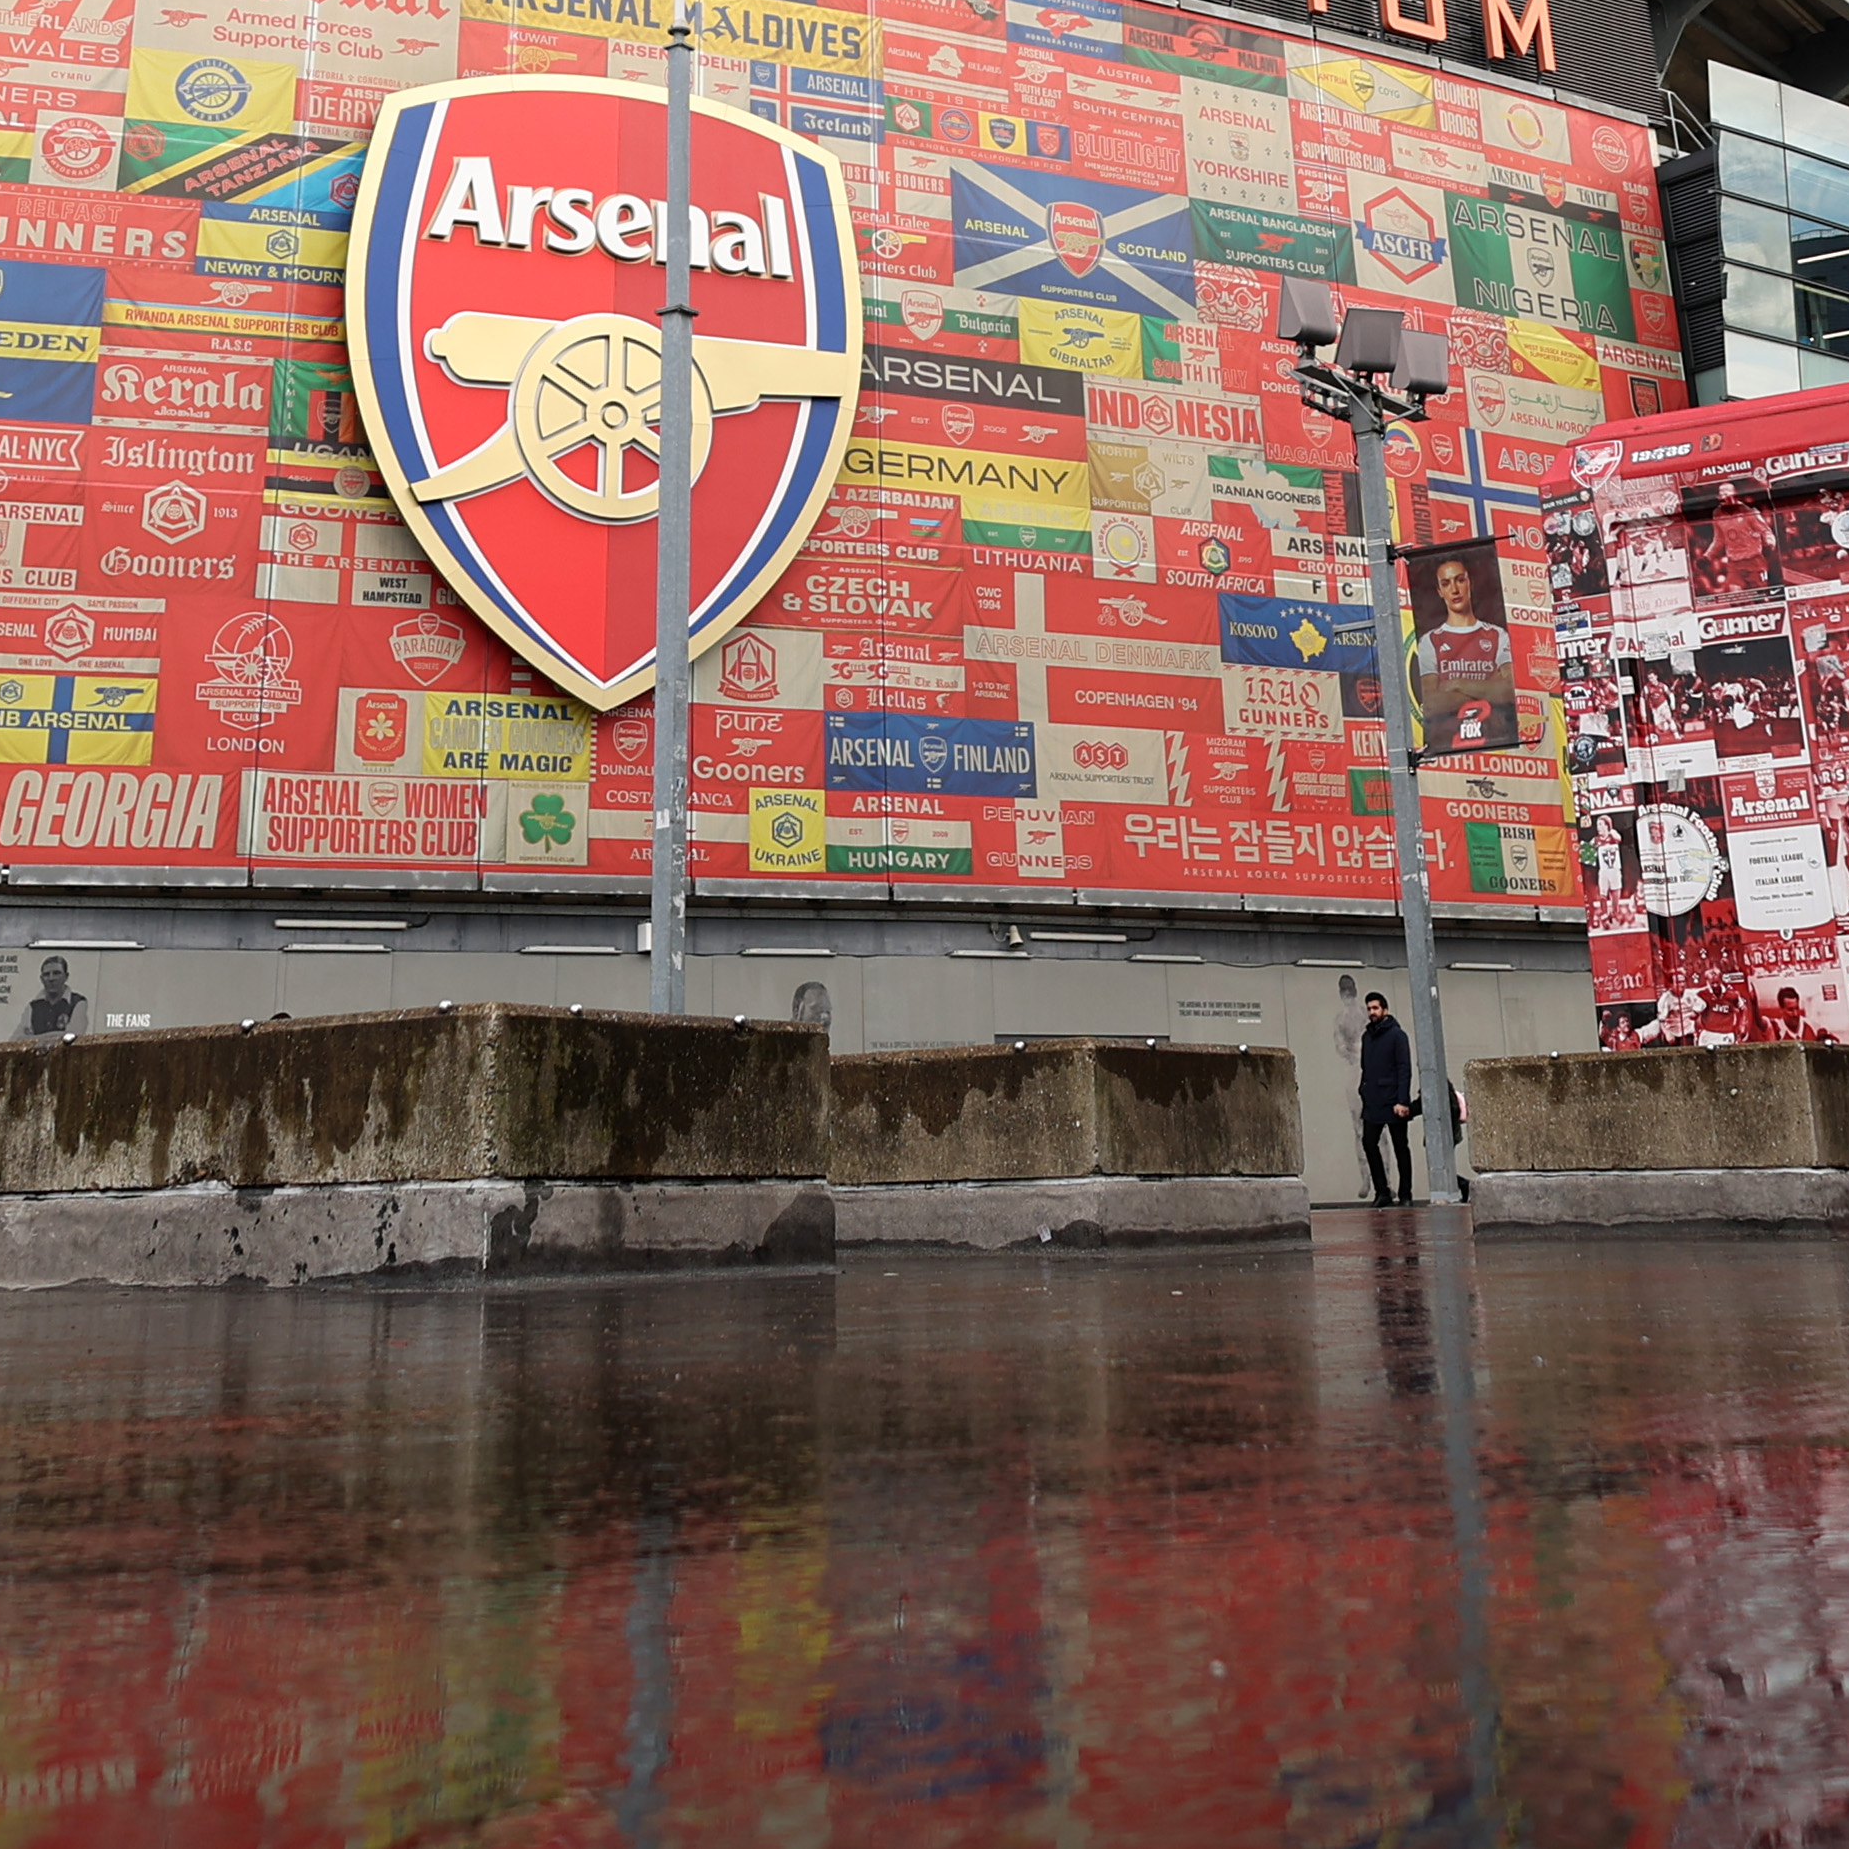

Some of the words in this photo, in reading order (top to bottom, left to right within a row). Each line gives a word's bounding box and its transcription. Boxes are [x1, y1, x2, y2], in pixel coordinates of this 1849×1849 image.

[213, 26, 332, 52] Supporters
[337, 41, 384, 60] Club
[807, 74, 867, 98] ARSENAL
[1096, 66, 1153, 84] AUSTRIA
[1072, 100, 1118, 117] SOUTH
[1122, 109, 1179, 128] CENTRAL
[1199, 106, 1276, 133] ARSENAL
[1073, 131, 1180, 172] BLUELIGHT
[1193, 159, 1289, 188] YORKSHIRE
[424, 157, 794, 282] Arsenal
[1452, 198, 1620, 261] ARSENAL
[1372, 231, 1433, 261] ASCFR
[1225, 249, 1293, 270] SUPPORTERS
[1297, 258, 1326, 275] CLUB
[1474, 278, 1618, 333] NIGERIA
[1602, 345, 1678, 374] ARSENAL
[101, 363, 265, 411] Kerala
[859, 355, 1061, 404] ARSENAL
[101, 437, 255, 477] Islington
[844, 448, 1070, 495] GERMANY
[847, 488, 954, 510] AZERBAIJAN
[1213, 483, 1263, 500] IRANIAN
[1266, 490, 1321, 505] GOONERS
[973, 548, 1082, 573] LITHUANIA
[1298, 560, 1363, 576] CROYDON
[25, 571, 74, 586] CLUB
[806, 574, 911, 598] CZECH
[782, 593, 802, 610] &
[807, 595, 933, 619] SLOVAK
[1229, 621, 1277, 640] KOSOVO
[1702, 612, 1782, 639] Gunner
[1440, 658, 1494, 673] Emirates
[1075, 690, 1175, 709] COPENHAGEN
[27, 712, 131, 730] ARSENAL
[1460, 723, 1482, 739] FOX
[206, 736, 285, 753] LONDON
[830, 737, 914, 768] ARSENAL
[954, 743, 1031, 774] FINLAND
[443, 751, 488, 770] ARE
[499, 753, 573, 772] MAGIC
[693, 756, 805, 783] Gooners
[263, 777, 361, 814] ARSENAL
[404, 782, 488, 819] WOMEN
[755, 794, 818, 812] ARSENAL
[1731, 794, 1809, 817] Arsenal
[1446, 801, 1530, 822] GOONERS
[267, 816, 416, 856] SUPPORTERS
[421, 821, 478, 856] CLUB
[1124, 812, 1222, 861] 우리는
[1228, 821, 1327, 867] 잠들지
[1497, 826, 1536, 842] IRISH
[754, 849, 824, 867] UKRAINE
[849, 852, 950, 870] HUNGARY
[1489, 875, 1556, 892] GOONERS
[106, 1013, 124, 1027] THE
[125, 1013, 151, 1028] FANS
